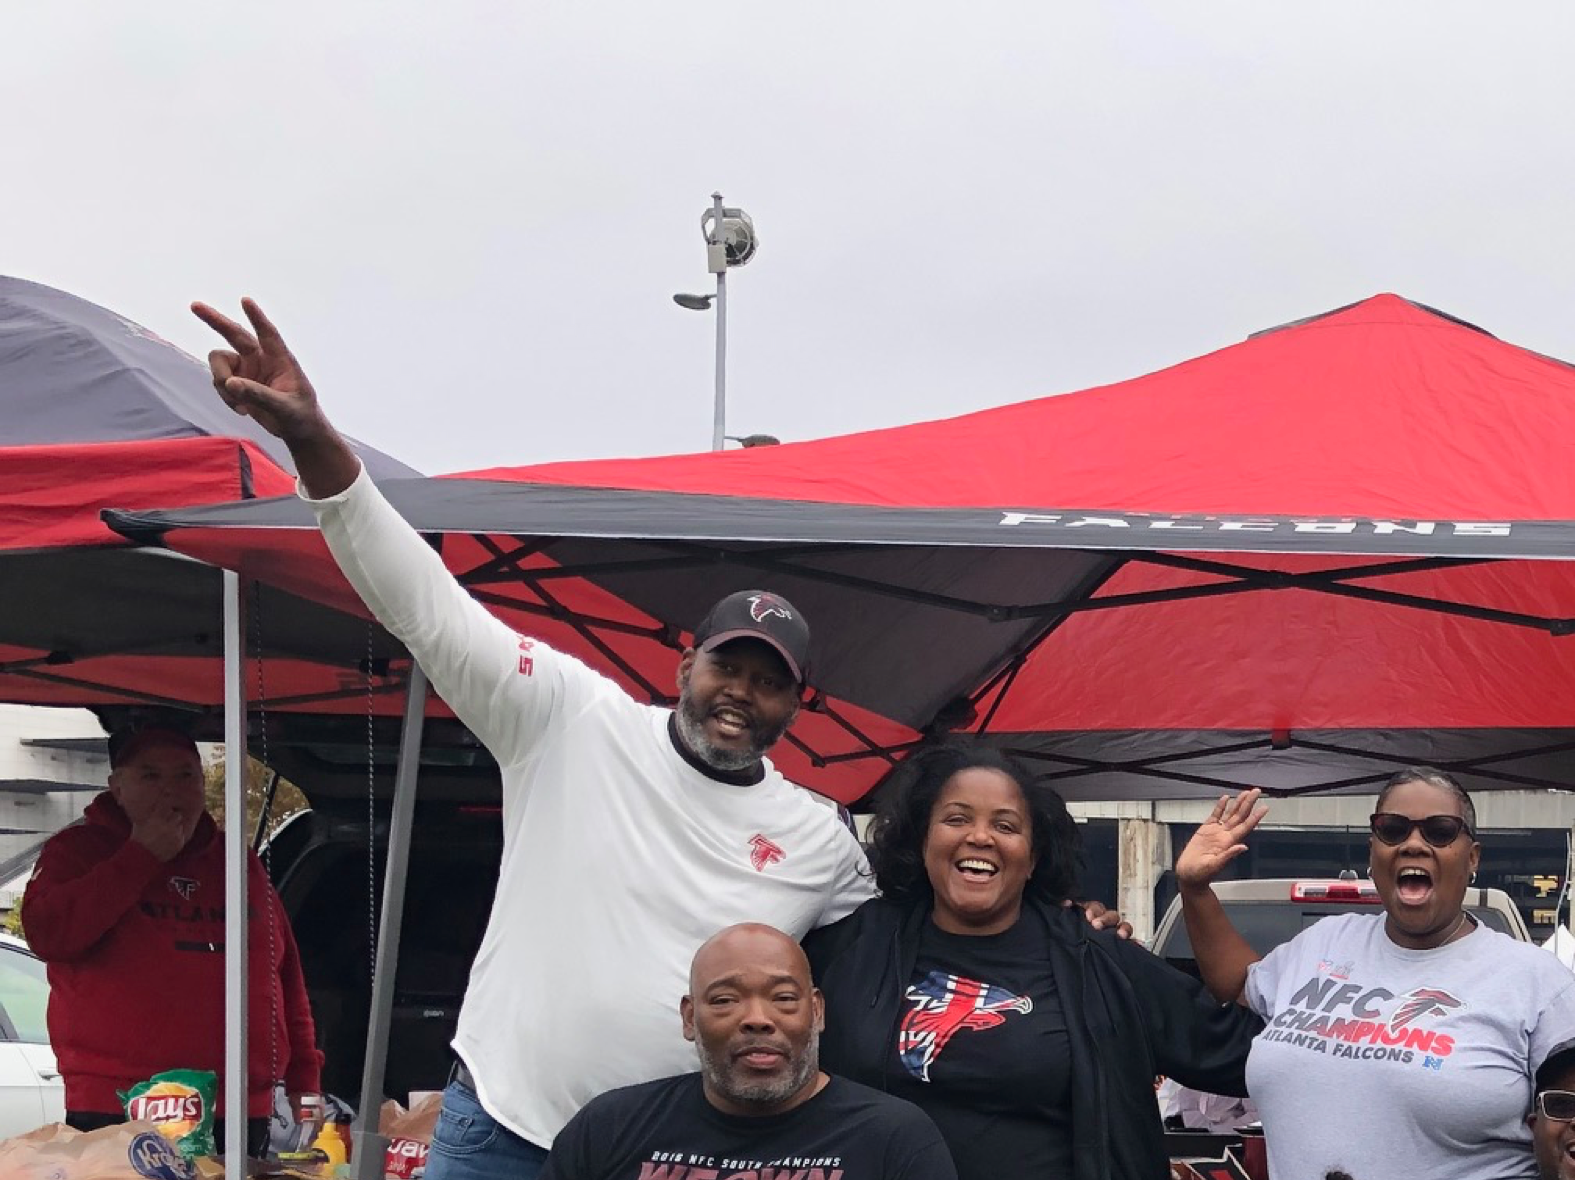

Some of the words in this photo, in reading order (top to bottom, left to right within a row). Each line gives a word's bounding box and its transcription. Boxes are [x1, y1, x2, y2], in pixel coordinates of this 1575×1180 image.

[999, 511, 1512, 537] FALCONS
[1289, 977, 1395, 1019] NFC
[1262, 1029, 1327, 1054] ATLANTA
[1332, 1043, 1414, 1064] FALCONS
[1273, 1008, 1456, 1057] CHAMPIONS
[651, 1151, 683, 1162] 2016
[688, 1154, 714, 1167] NFC
